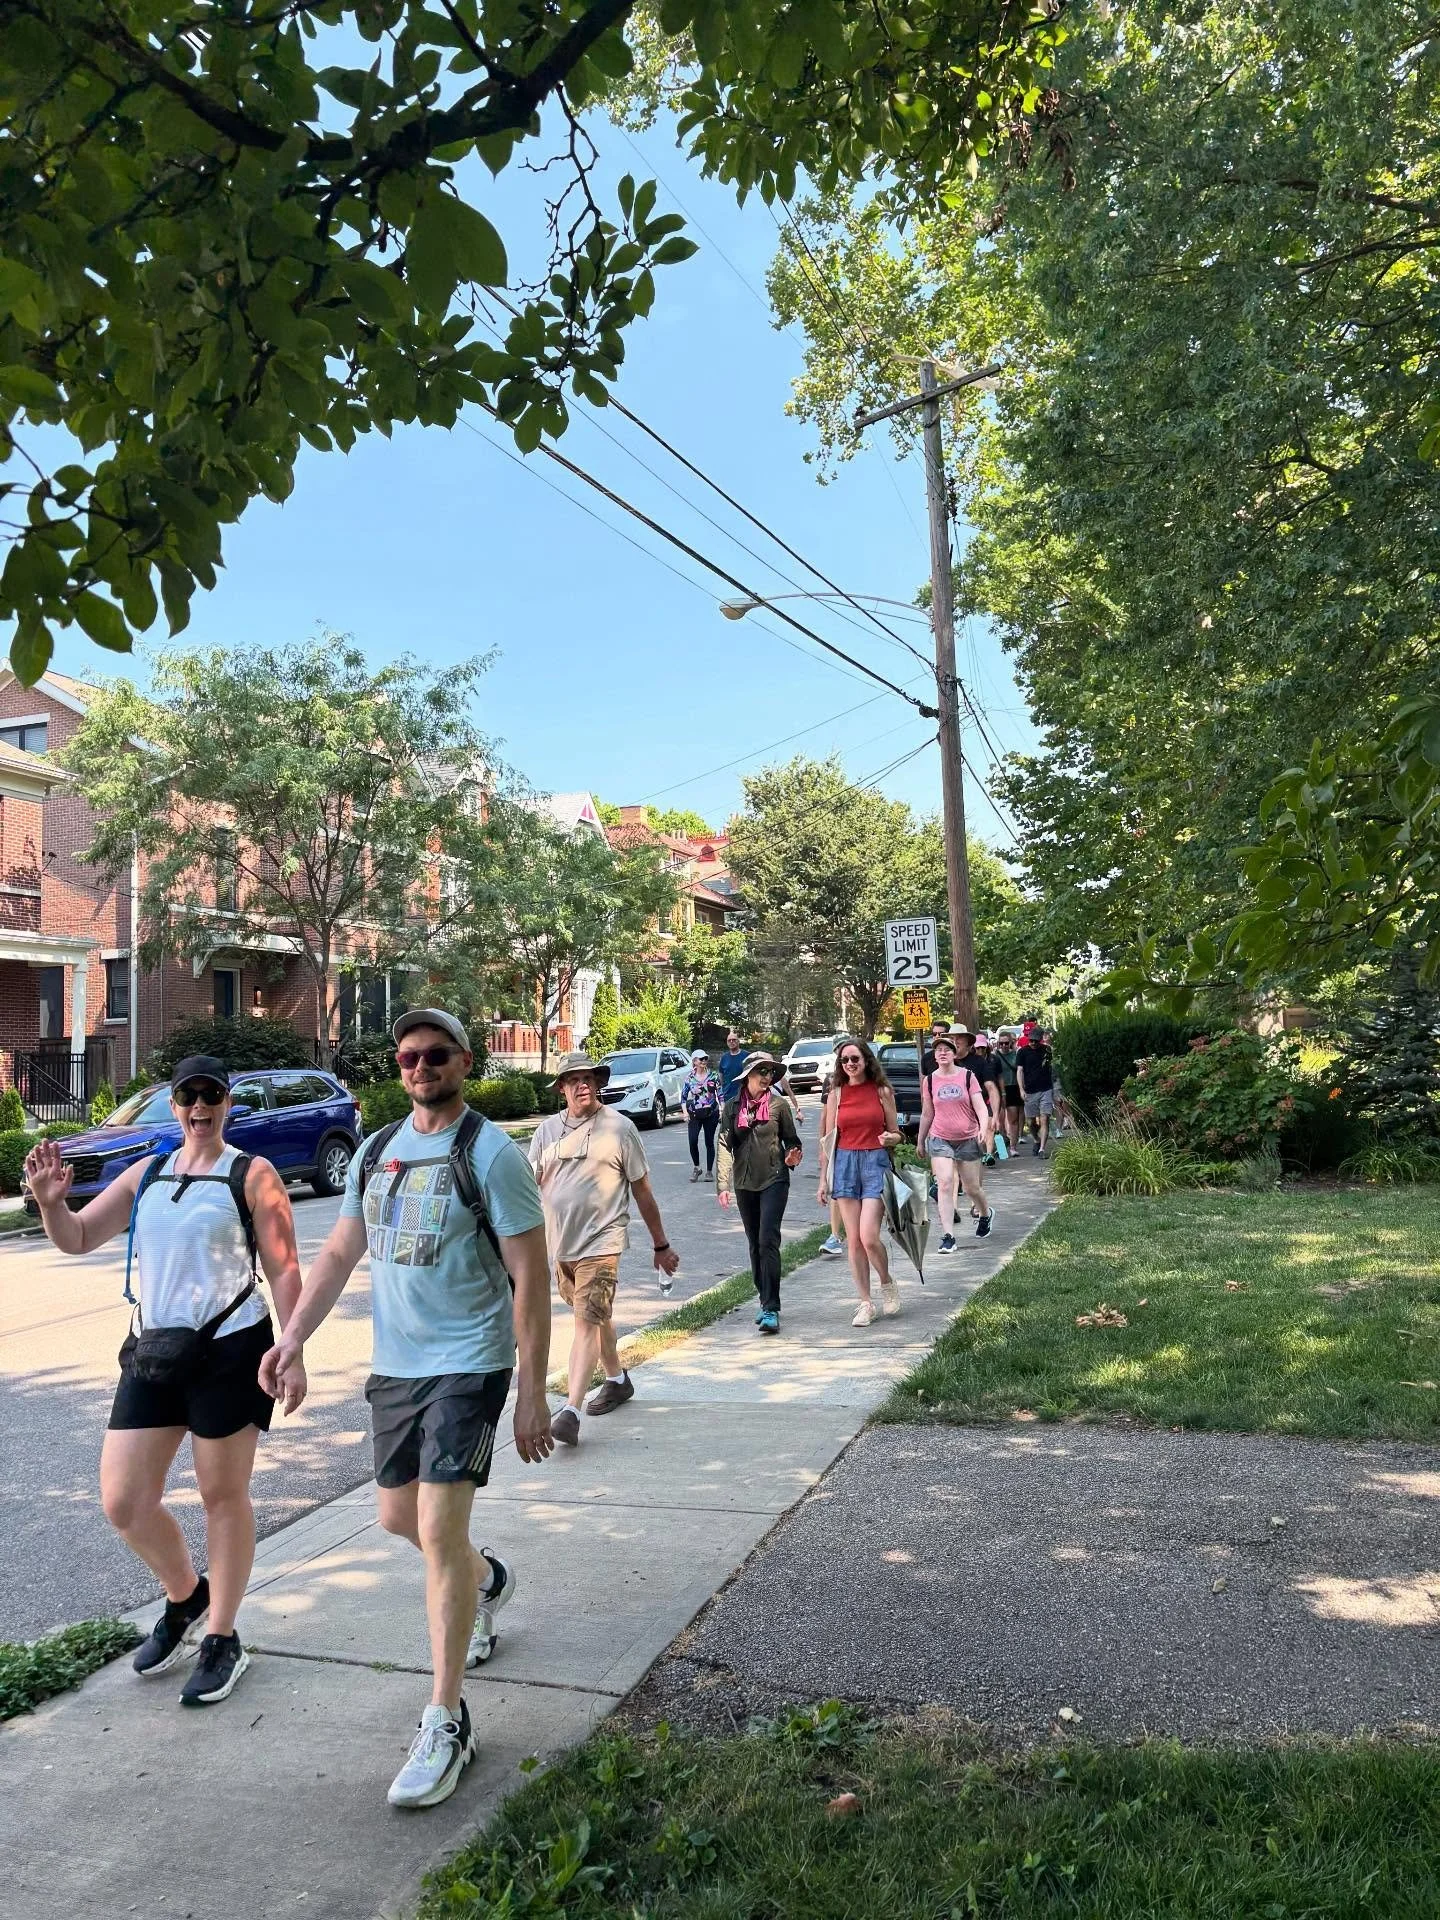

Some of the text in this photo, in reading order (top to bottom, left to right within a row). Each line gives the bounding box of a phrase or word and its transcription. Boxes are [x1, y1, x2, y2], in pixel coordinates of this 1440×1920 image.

[891, 924, 930, 938] SPEED
[895, 939, 927, 952] LIMIT
[893, 955, 932, 980] 25
